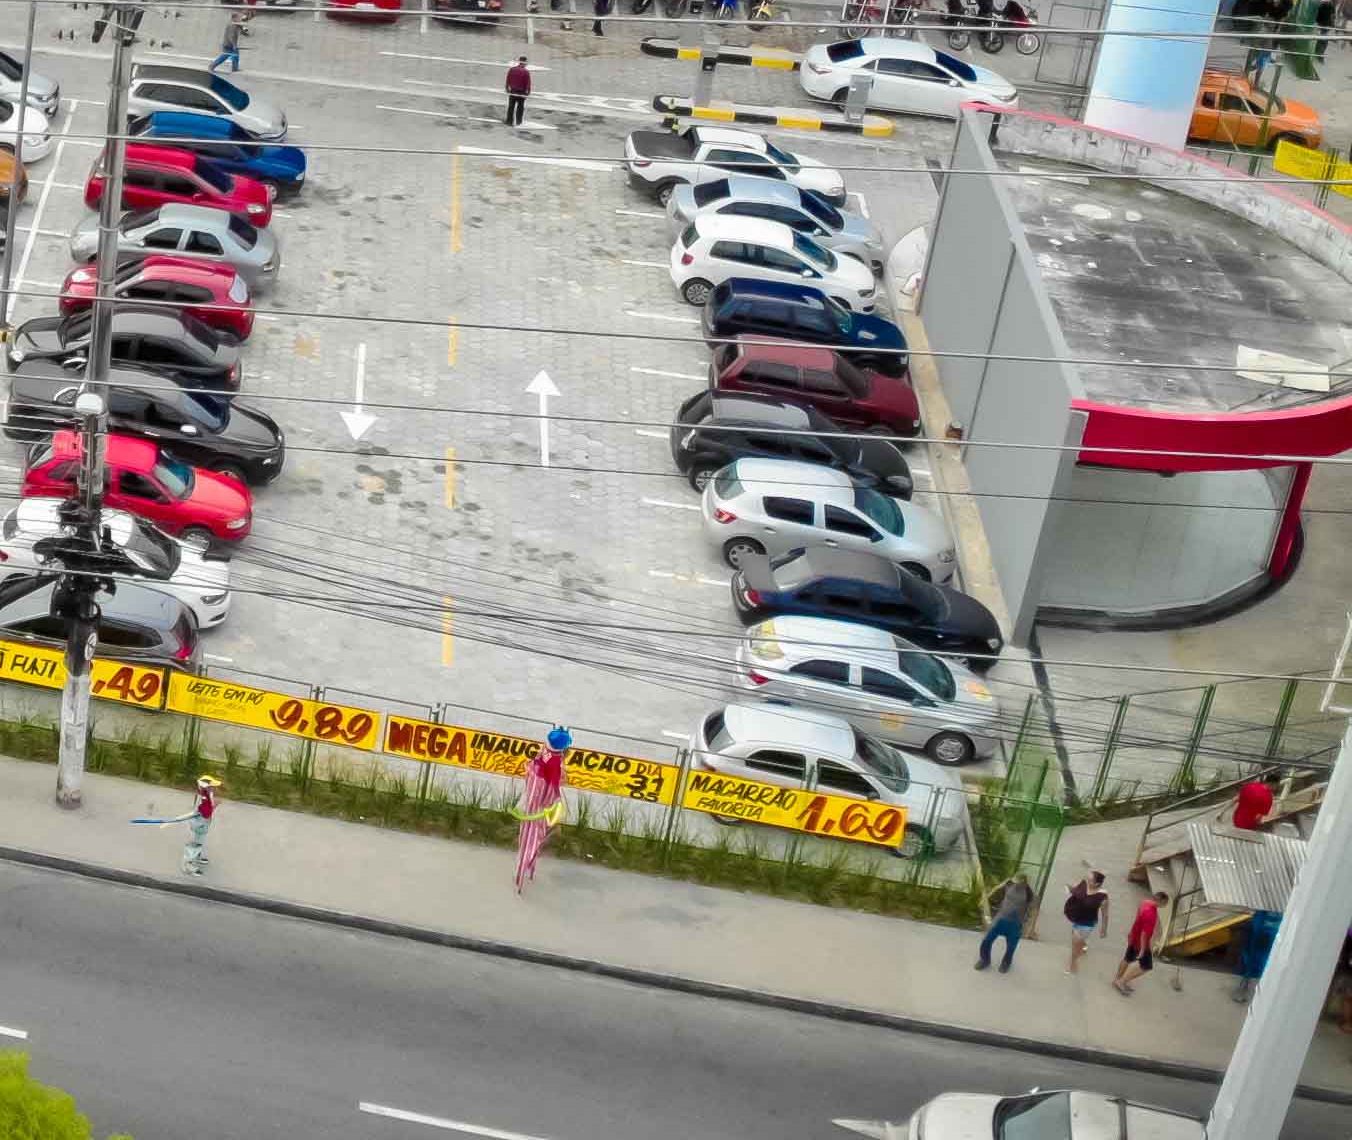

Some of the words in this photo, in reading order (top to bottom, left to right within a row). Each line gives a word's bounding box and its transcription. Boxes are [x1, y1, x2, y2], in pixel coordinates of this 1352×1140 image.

[223, 688, 246, 702] EM
[388, 721, 467, 764] MEGA
[635, 762, 662, 776] DIA
[625, 774, 664, 791] 31
[689, 776, 796, 810] MACARRÃO
[696, 797, 763, 820] FAVORITA
